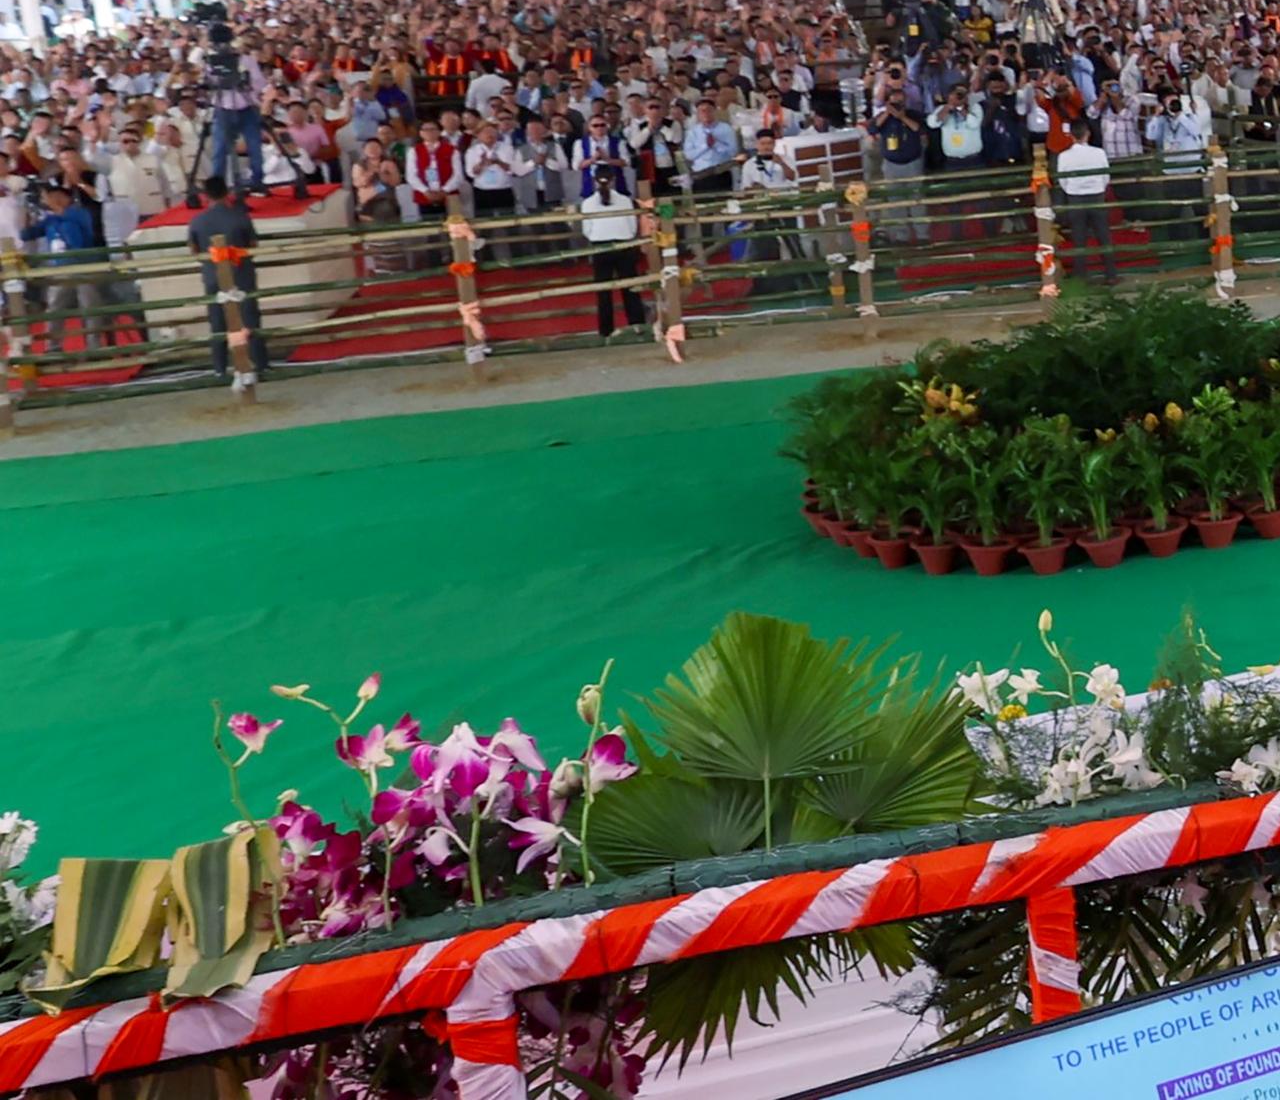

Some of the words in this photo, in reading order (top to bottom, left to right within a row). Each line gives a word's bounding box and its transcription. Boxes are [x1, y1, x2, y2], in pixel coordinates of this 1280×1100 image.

[1052, 1049, 1082, 1072] TO
[1086, 1036, 1129, 1061] THE
[1133, 1009, 1215, 1049] PEOPLE
[1219, 999, 1244, 1020] OF
[1163, 1072, 1214, 1100] LAYING
[1215, 1065, 1235, 1085] OF
